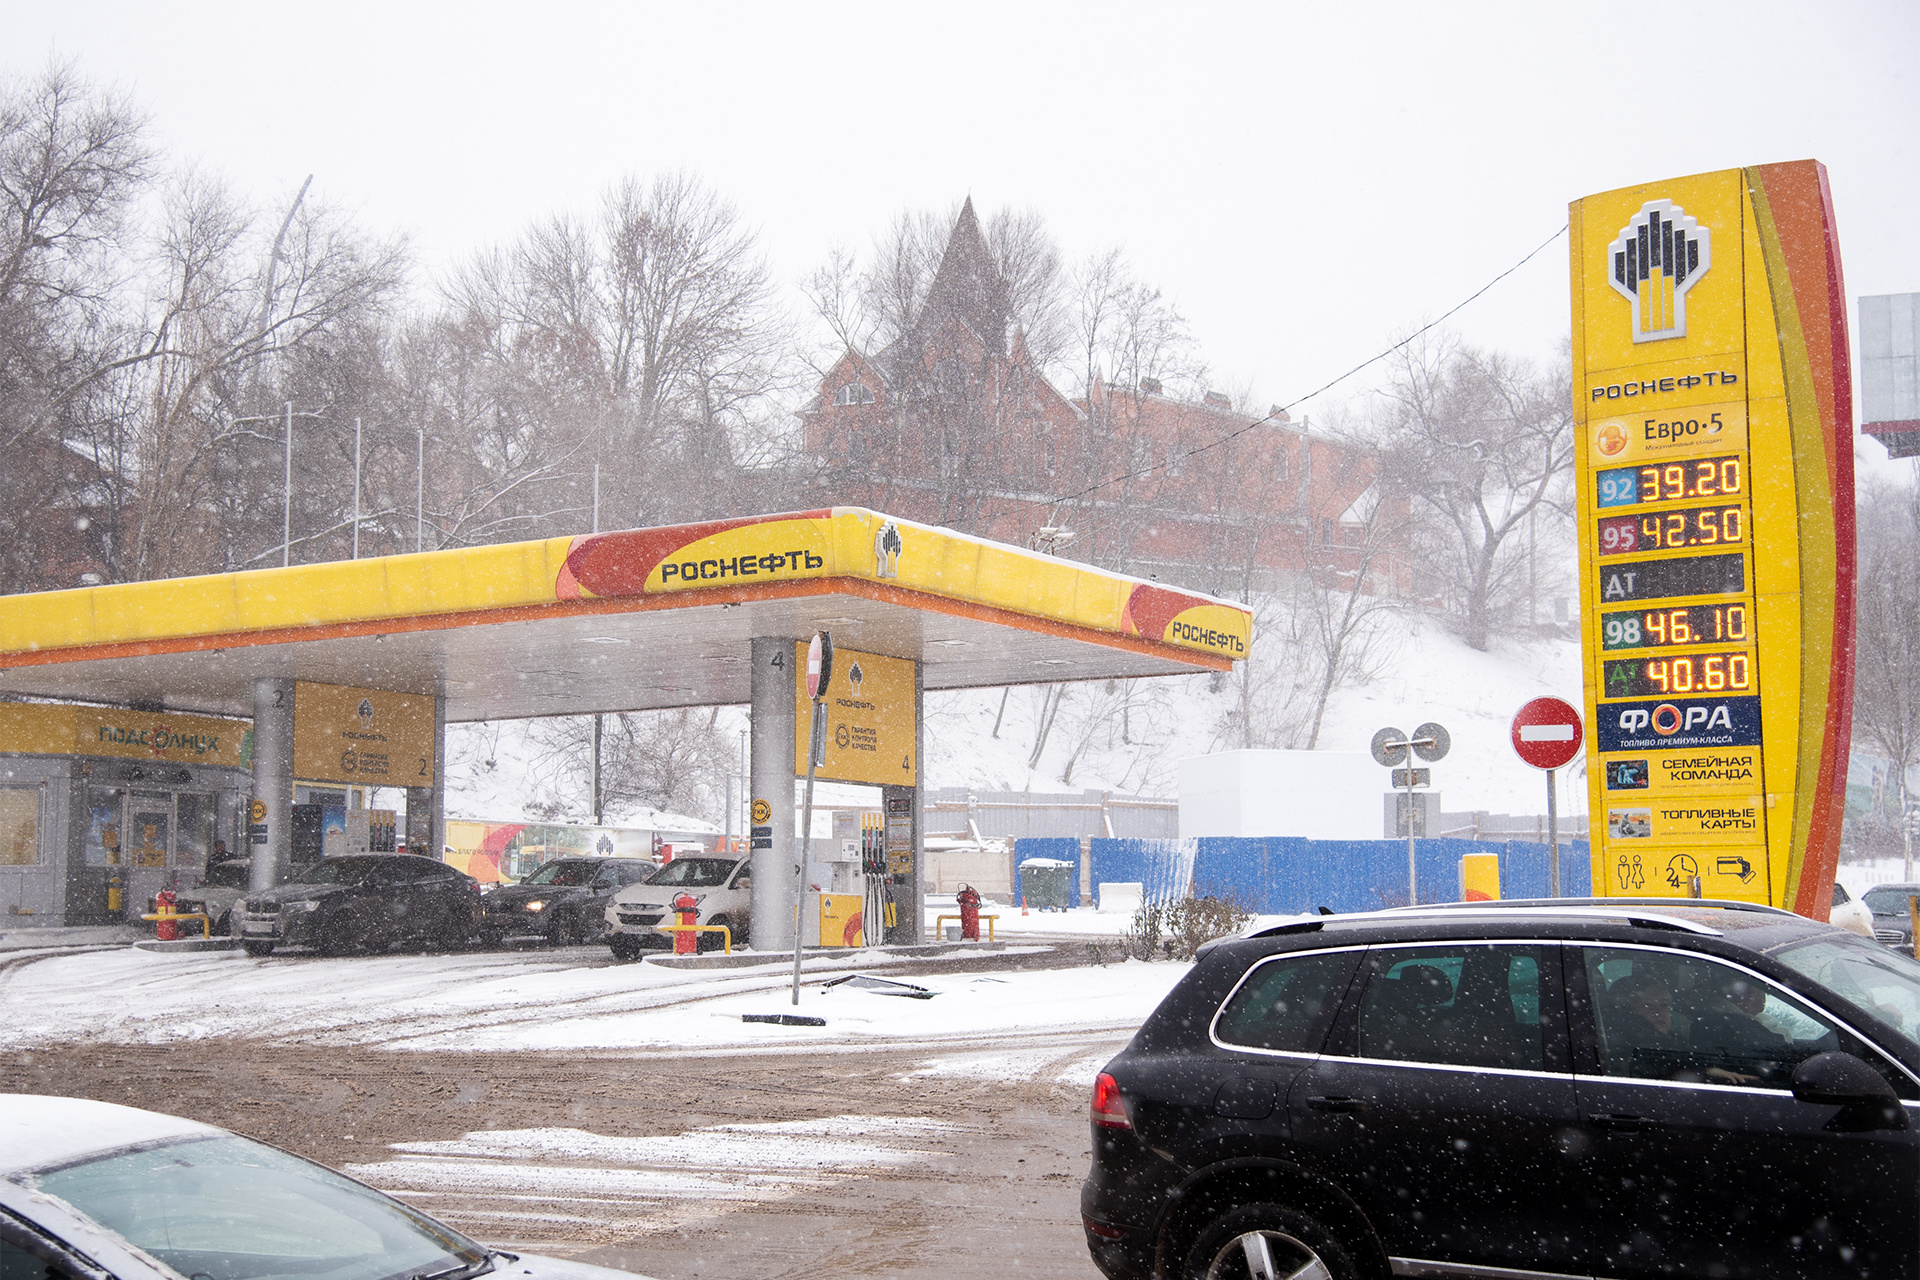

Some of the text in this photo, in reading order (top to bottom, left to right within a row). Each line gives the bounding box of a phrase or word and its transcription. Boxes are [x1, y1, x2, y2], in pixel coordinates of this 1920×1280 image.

[1592, 371, 1738, 402] РОСНЕФТЬ
[1602, 459, 1741, 502] 92 39.20
[1603, 508, 1742, 549] 95 42.50
[661, 550, 824, 583] РОСНЕФТЬ
[1605, 572, 1637, 599] ДТ
[1606, 606, 1746, 645] 98 46.10
[1172, 621, 1244, 652] РОСНЕФТЬ
[771, 651, 785, 671] 4
[1610, 654, 1749, 692] ДТ 40.60
[272, 689, 284, 708] 2
[836, 698, 876, 711] РОСНЕФТЬ
[1619, 703, 1733, 736] ФОРА
[100, 726, 220, 755] ПОДСОЛНУХ
[342, 731, 388, 742] РОСНЕФТЬ
[1620, 734, 1733, 748] ТОПЛИВО ПРЕМИУМ-КЛАССА
[418, 758, 427, 776] 2
[902, 754, 910, 774] 4
[1662, 755, 1752, 769] СЕМЕЙНАЯ
[1671, 768, 1753, 781] КОМАНДА
[1660, 808, 1755, 820] ТОПЛИВНЫЕ
[1700, 819, 1756, 830] КАРТЫ
